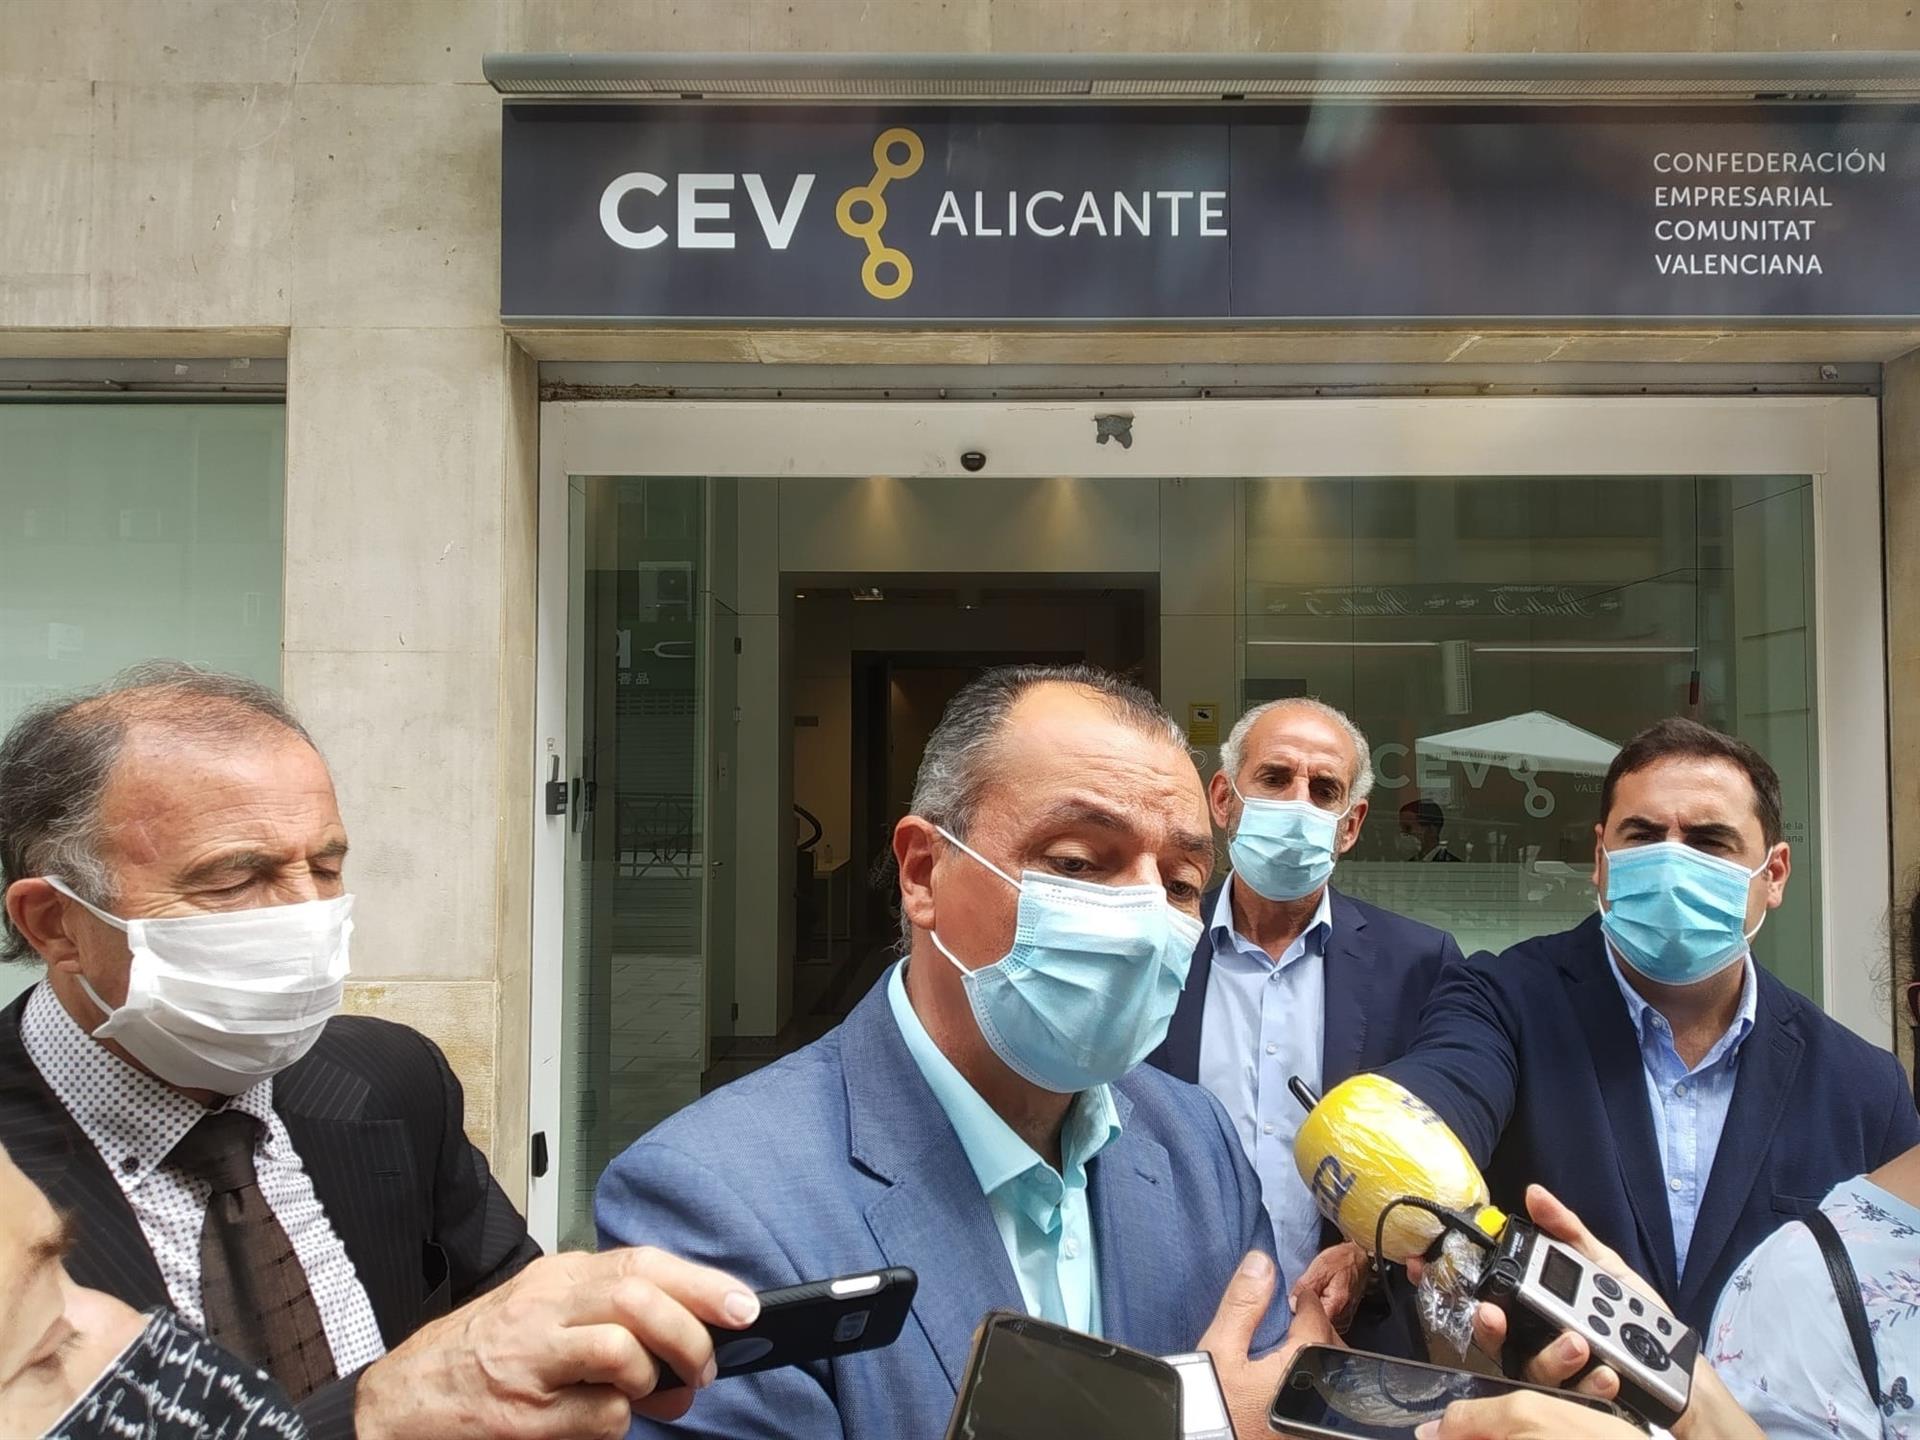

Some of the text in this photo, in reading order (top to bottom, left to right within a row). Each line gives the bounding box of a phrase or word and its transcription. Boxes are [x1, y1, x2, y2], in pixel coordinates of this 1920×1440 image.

[1653, 148, 1887, 173] CONFEDERACIÓN
[1655, 186, 1833, 207] EMPRESARIAL
[599, 172, 1228, 250] CEV ALICANTE
[1654, 220, 1816, 241] COMUNITAT
[1655, 254, 1824, 275] VALENCIANA
[1371, 742, 1491, 788] CEV
[1574, 783, 1602, 793] VALE
